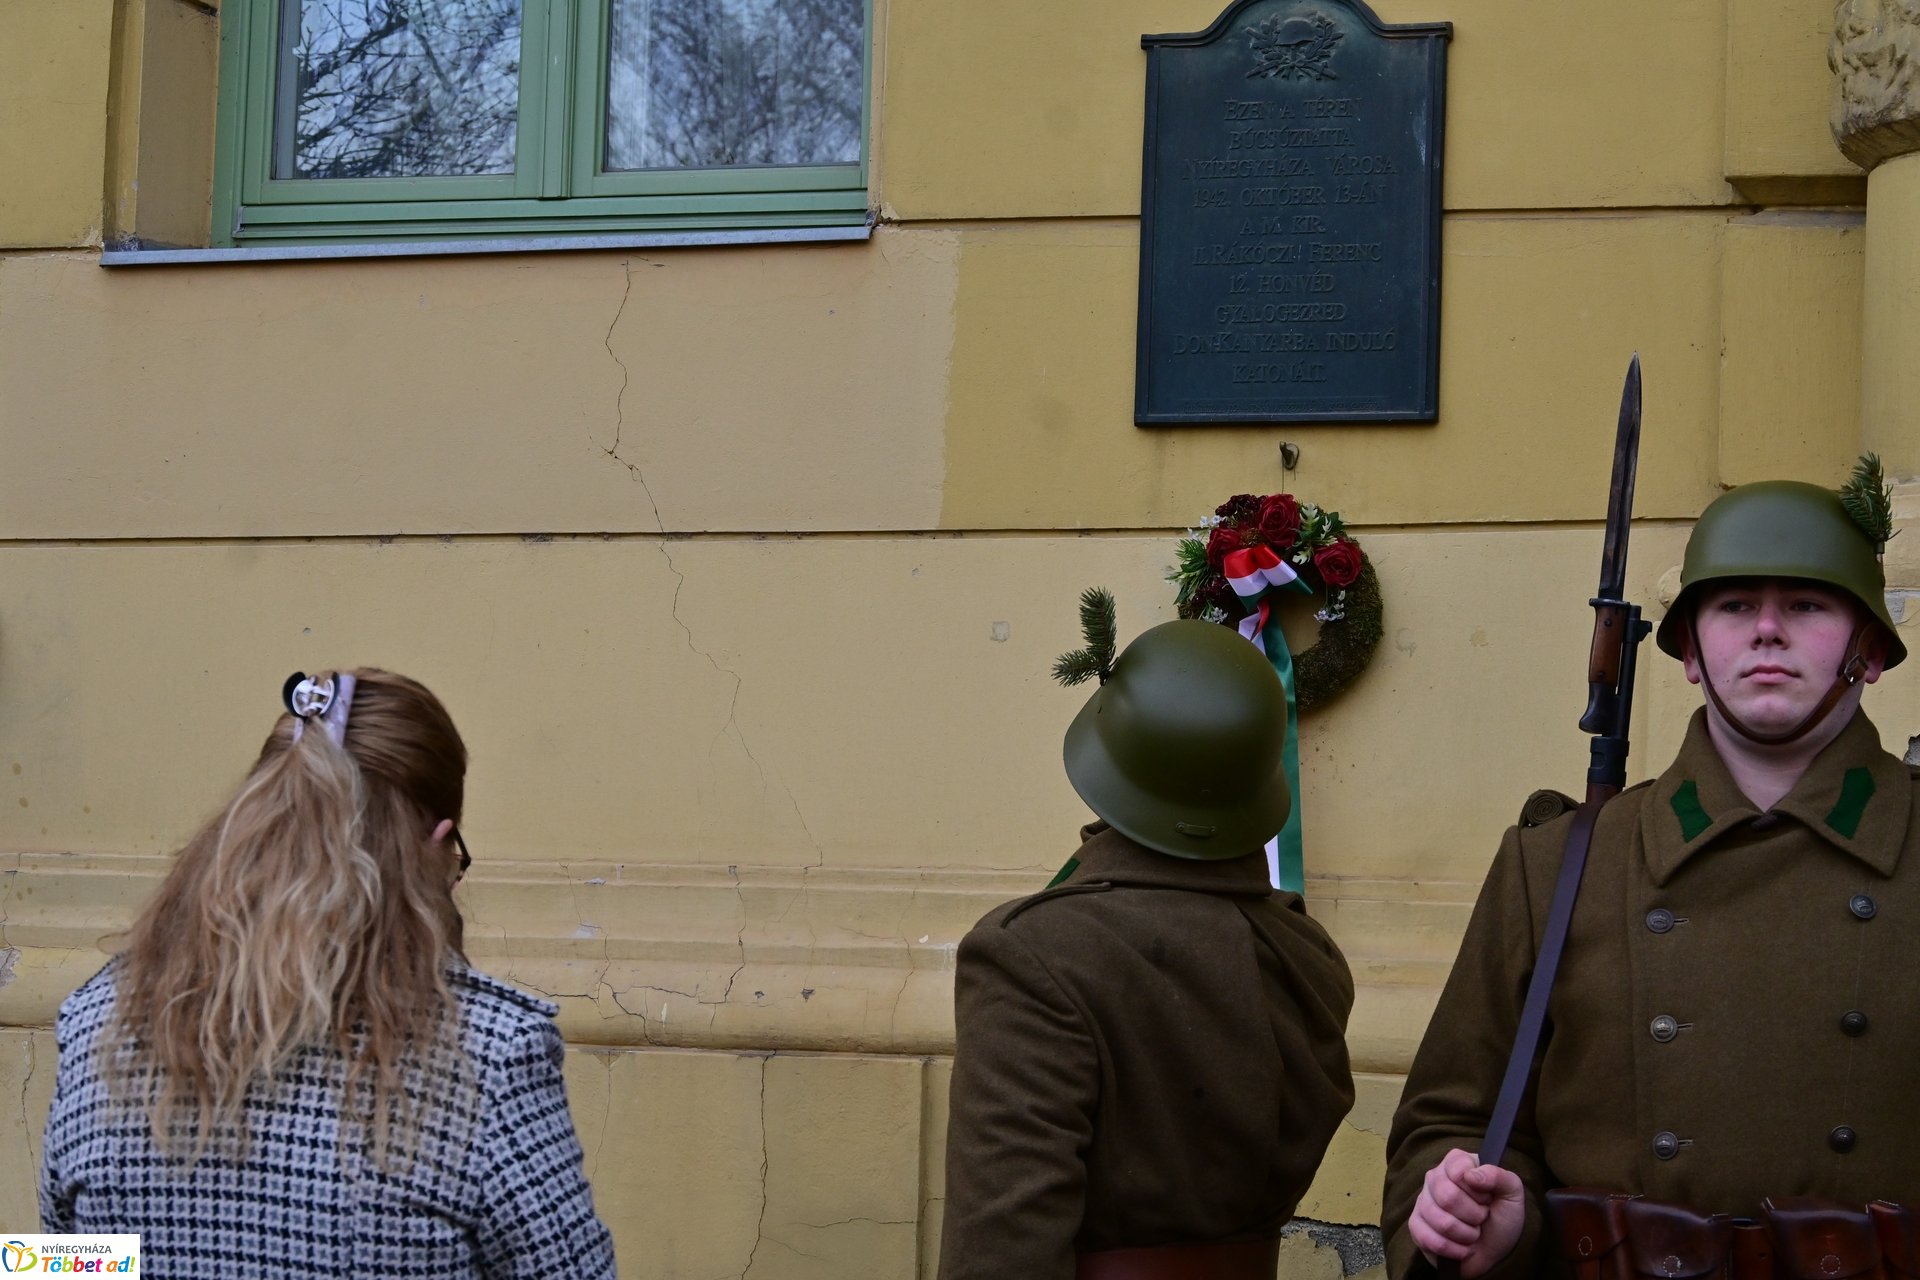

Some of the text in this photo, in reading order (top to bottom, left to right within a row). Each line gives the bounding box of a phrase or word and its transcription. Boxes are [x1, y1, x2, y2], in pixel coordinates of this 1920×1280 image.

[1223, 97, 1361, 120] EZEN A TÉREN
[1228, 127, 1354, 150] BÚCSÚZTATTA
[1182, 153, 1398, 180] NYÍREGYHÁZA VÁROSA
[1192, 181, 1385, 208] 1942. OKTÓBER 13-ÁN
[1240, 216, 1256, 235] A
[1211, 241, 1295, 264] RÁKÓCZI
[1308, 241, 1382, 263] FERENC
[1258, 269, 1336, 293] HONVÉD
[1215, 303, 1347, 324] GYALOGEZRED
[1326, 328, 1396, 352] INDULÓ
